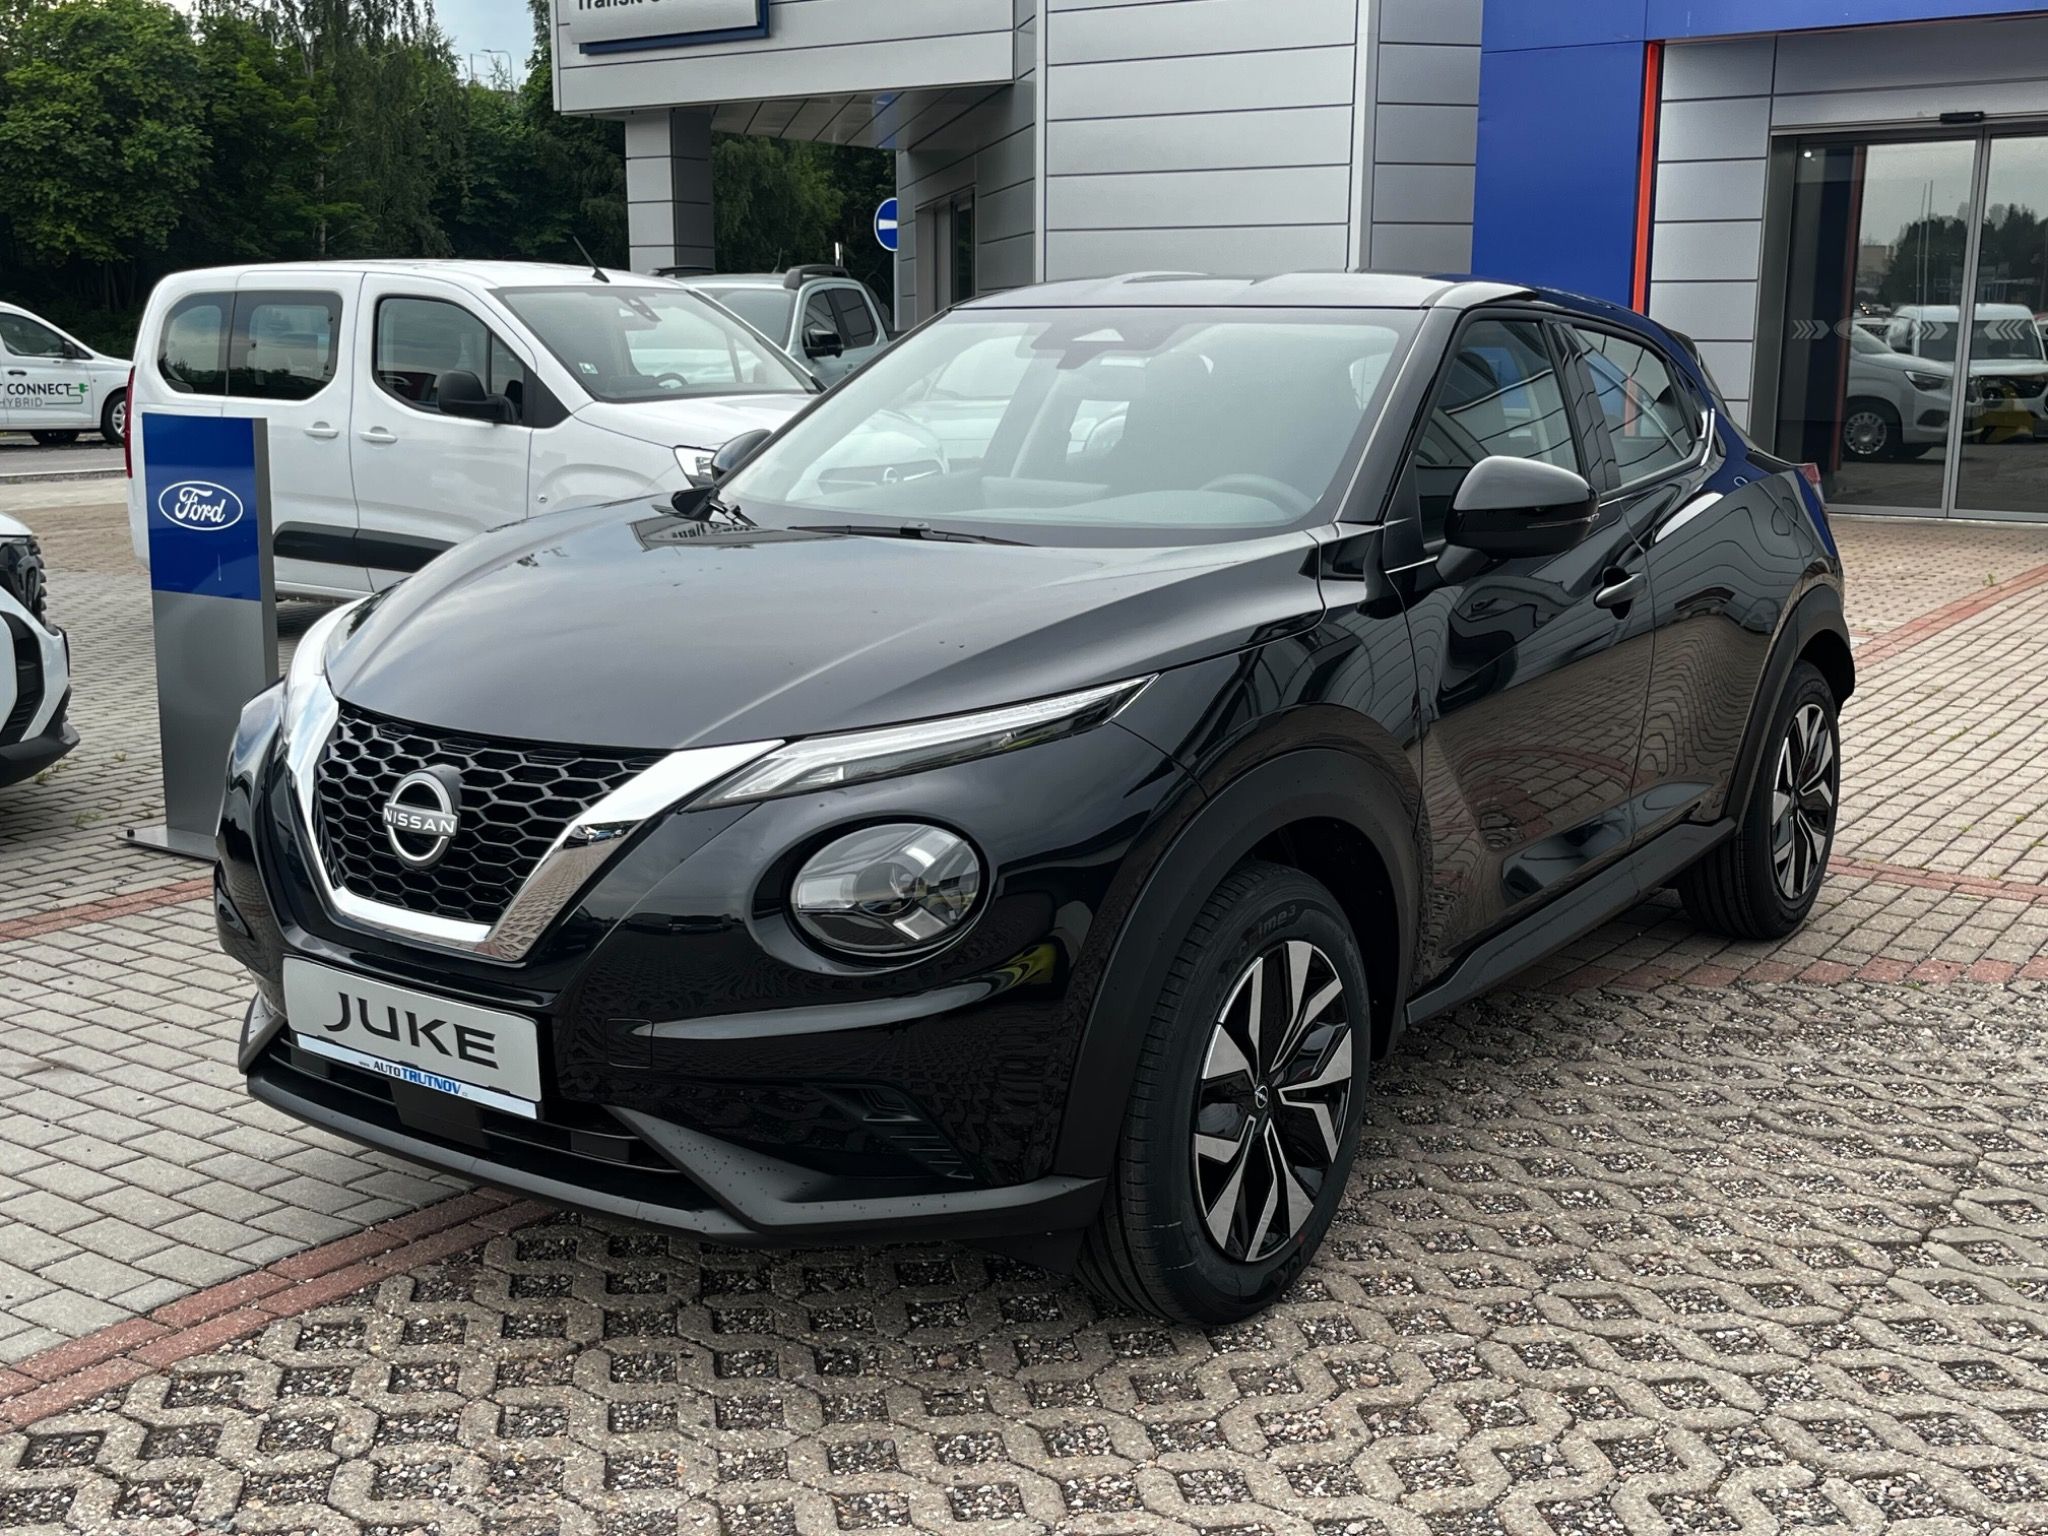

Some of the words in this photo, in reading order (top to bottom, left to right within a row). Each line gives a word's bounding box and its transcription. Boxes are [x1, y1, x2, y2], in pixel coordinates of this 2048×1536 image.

[578, 0, 643, 10] Trans
[7, 383, 71, 396] CONNECT
[174, 486, 227, 523] Ford
[383, 807, 455, 833] NISSAN
[323, 991, 499, 1070] JUKE
